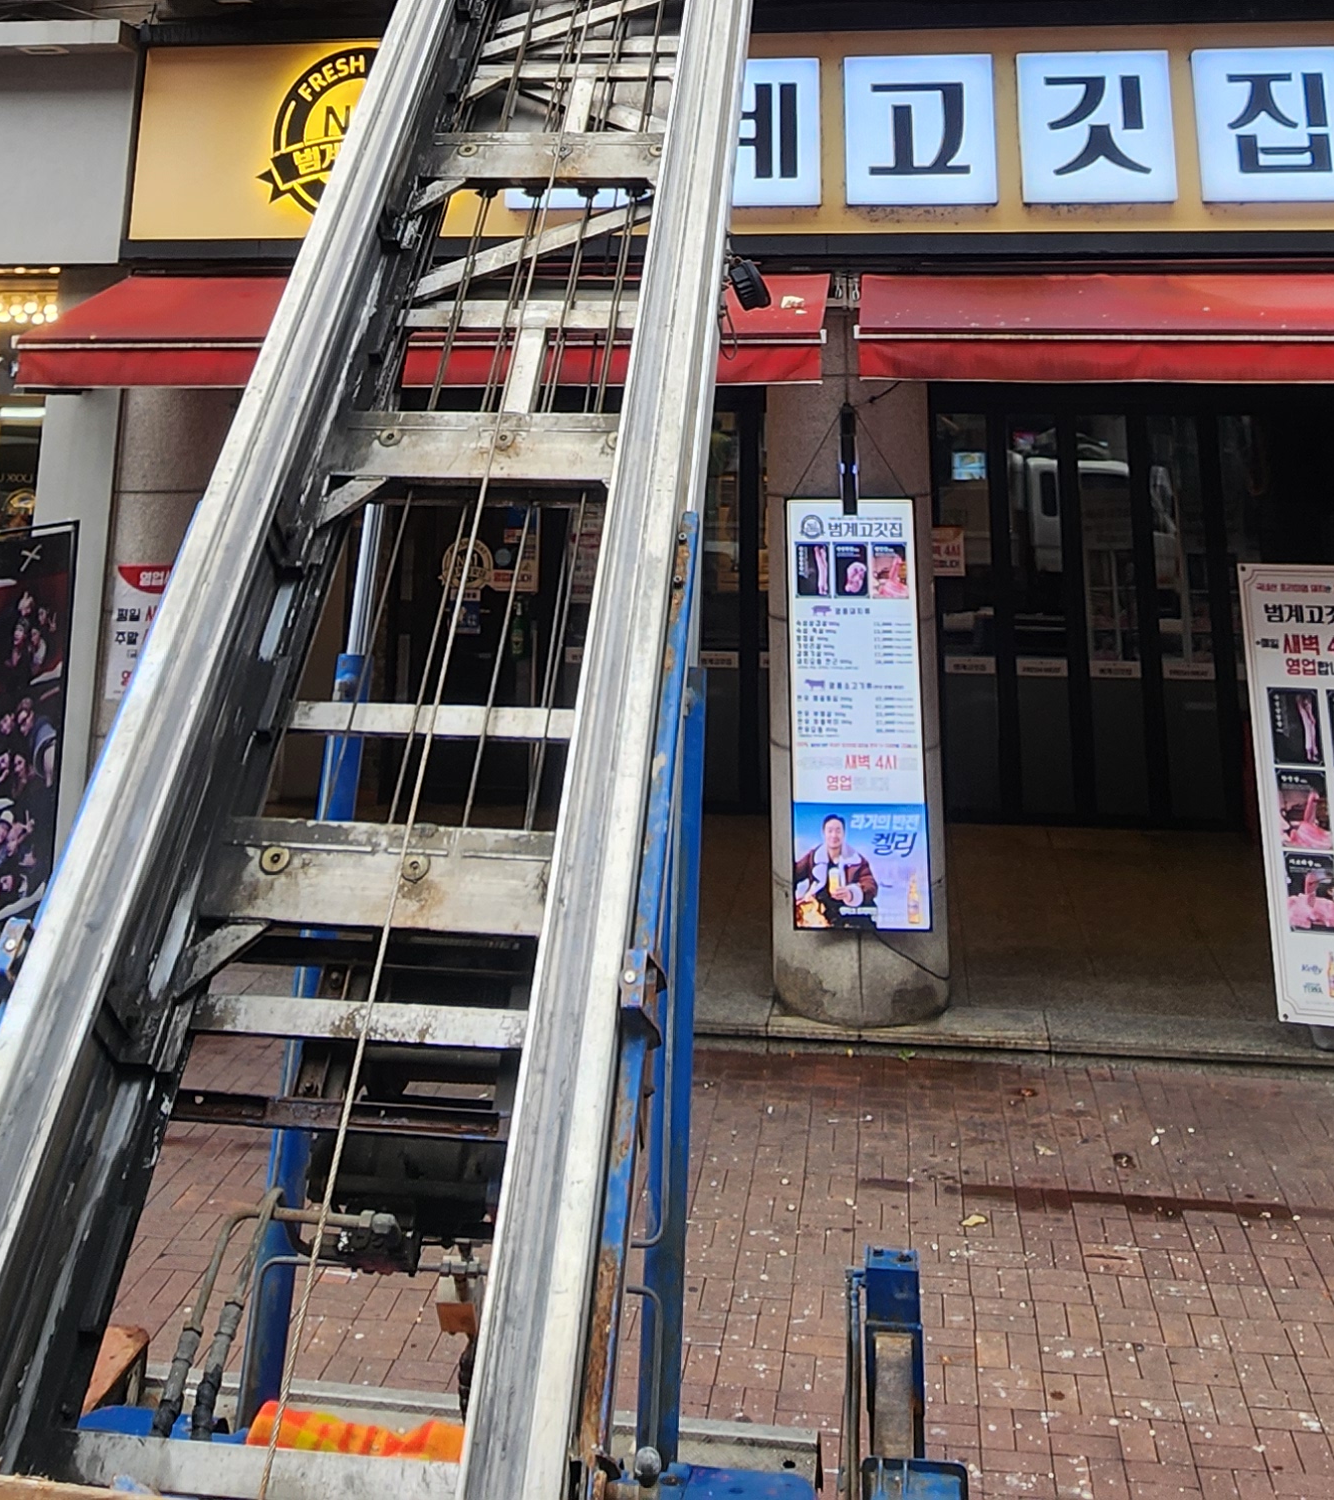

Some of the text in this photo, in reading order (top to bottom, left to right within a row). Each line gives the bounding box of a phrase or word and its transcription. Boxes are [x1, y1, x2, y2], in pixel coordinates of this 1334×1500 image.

[297, 53, 368, 101] FRESH
[828, 522, 903, 538] 범계고깃집
[117, 608, 140, 623] 평일
[115, 630, 139, 645] 주말
[1283, 634, 1320, 656] 새벽
[845, 755, 871, 770] 새벽
[875, 755, 898, 769] 4시
[826, 775, 853, 791] 영업
[871, 831, 917, 858] 켈리
